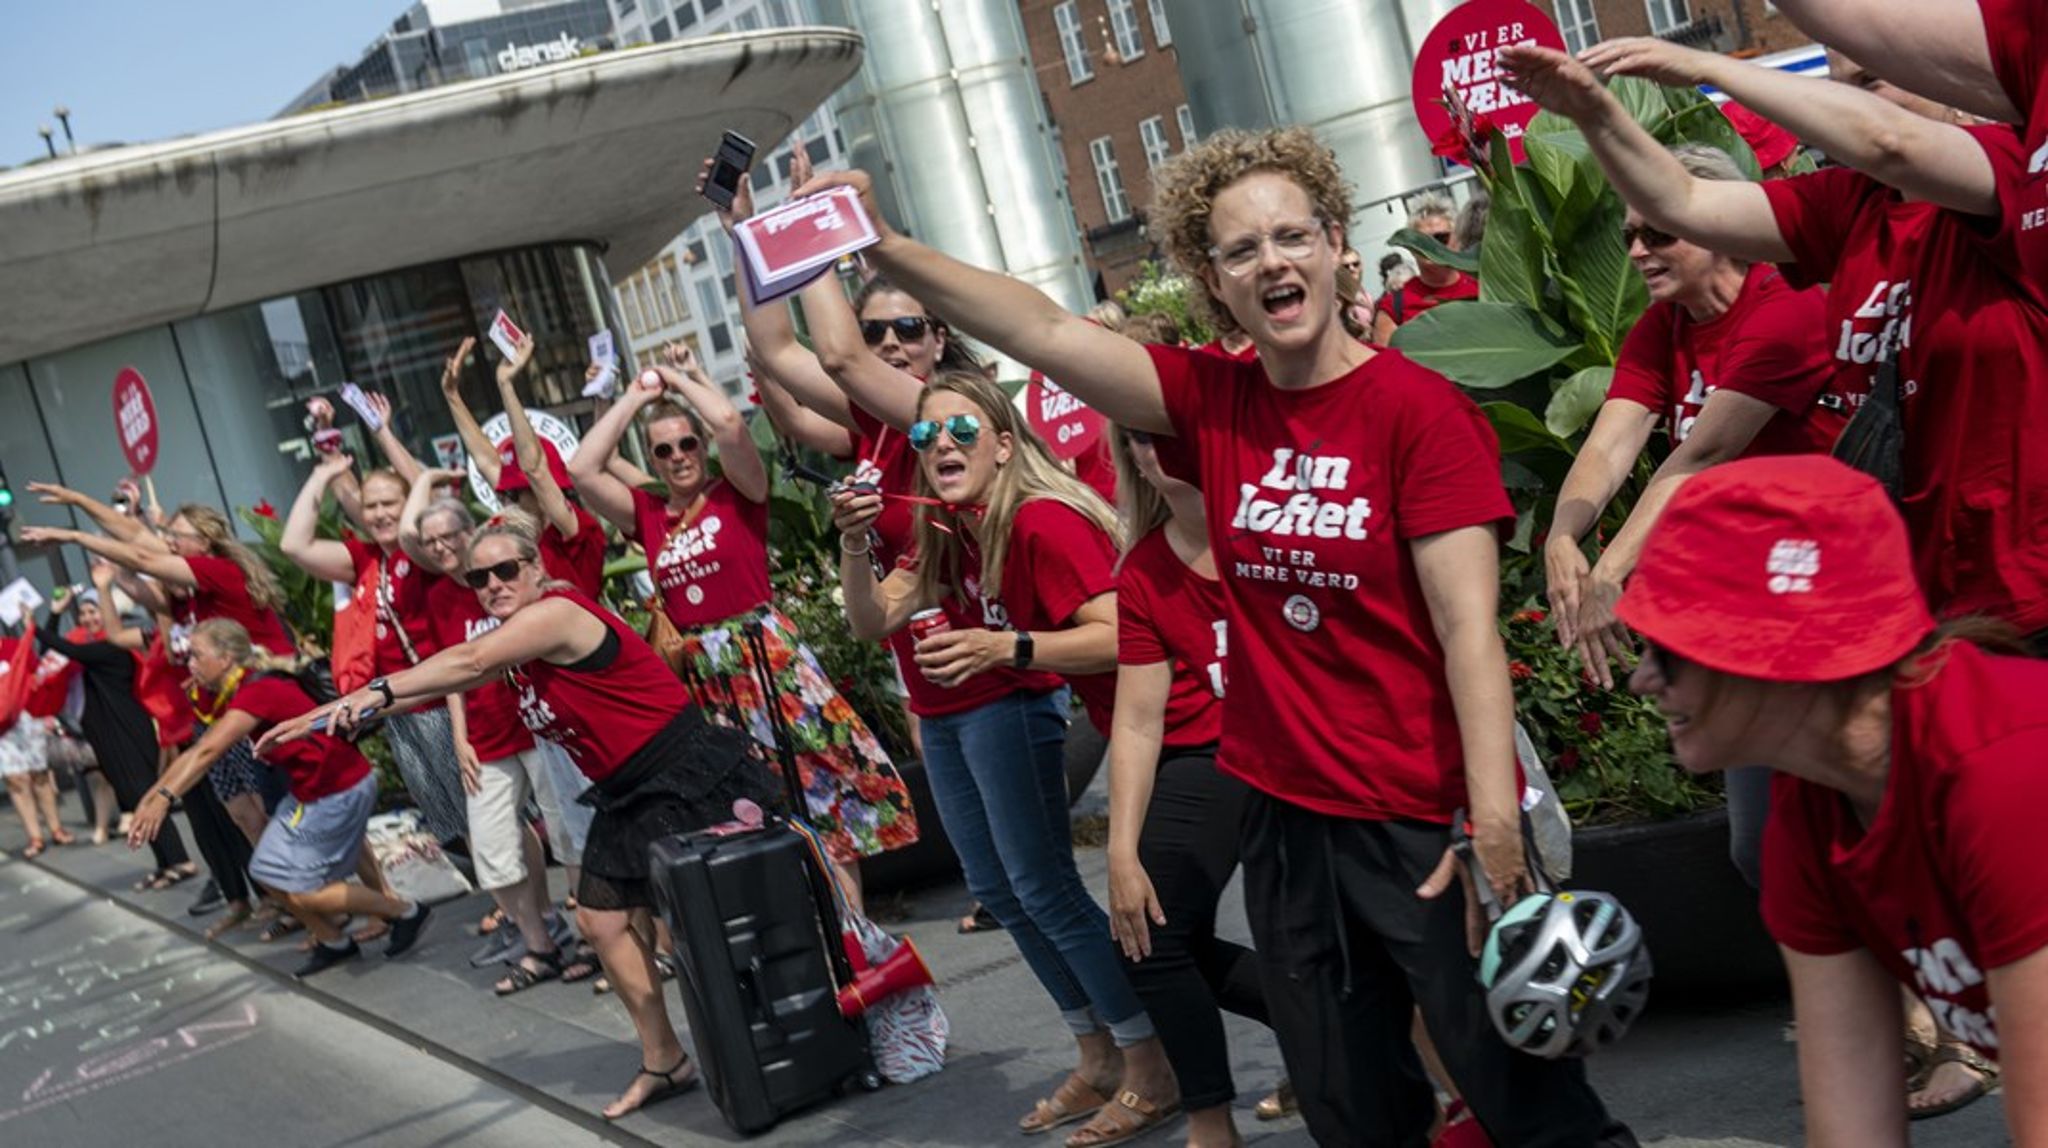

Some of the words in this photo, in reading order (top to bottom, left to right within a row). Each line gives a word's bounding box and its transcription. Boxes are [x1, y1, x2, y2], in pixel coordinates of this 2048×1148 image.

[1497, 22, 1525, 43] ER
[497, 31, 580, 72] dansk
[1441, 38, 1537, 86] ME
[1441, 78, 1533, 114] ÆR
[2021, 207, 2048, 231] ME
[1040, 391, 1088, 422] VÆR
[1262, 546, 1283, 562] VI
[1289, 549, 1316, 567] ER
[1234, 561, 1290, 582] MERE
[1295, 568, 1360, 591] VÆRD
